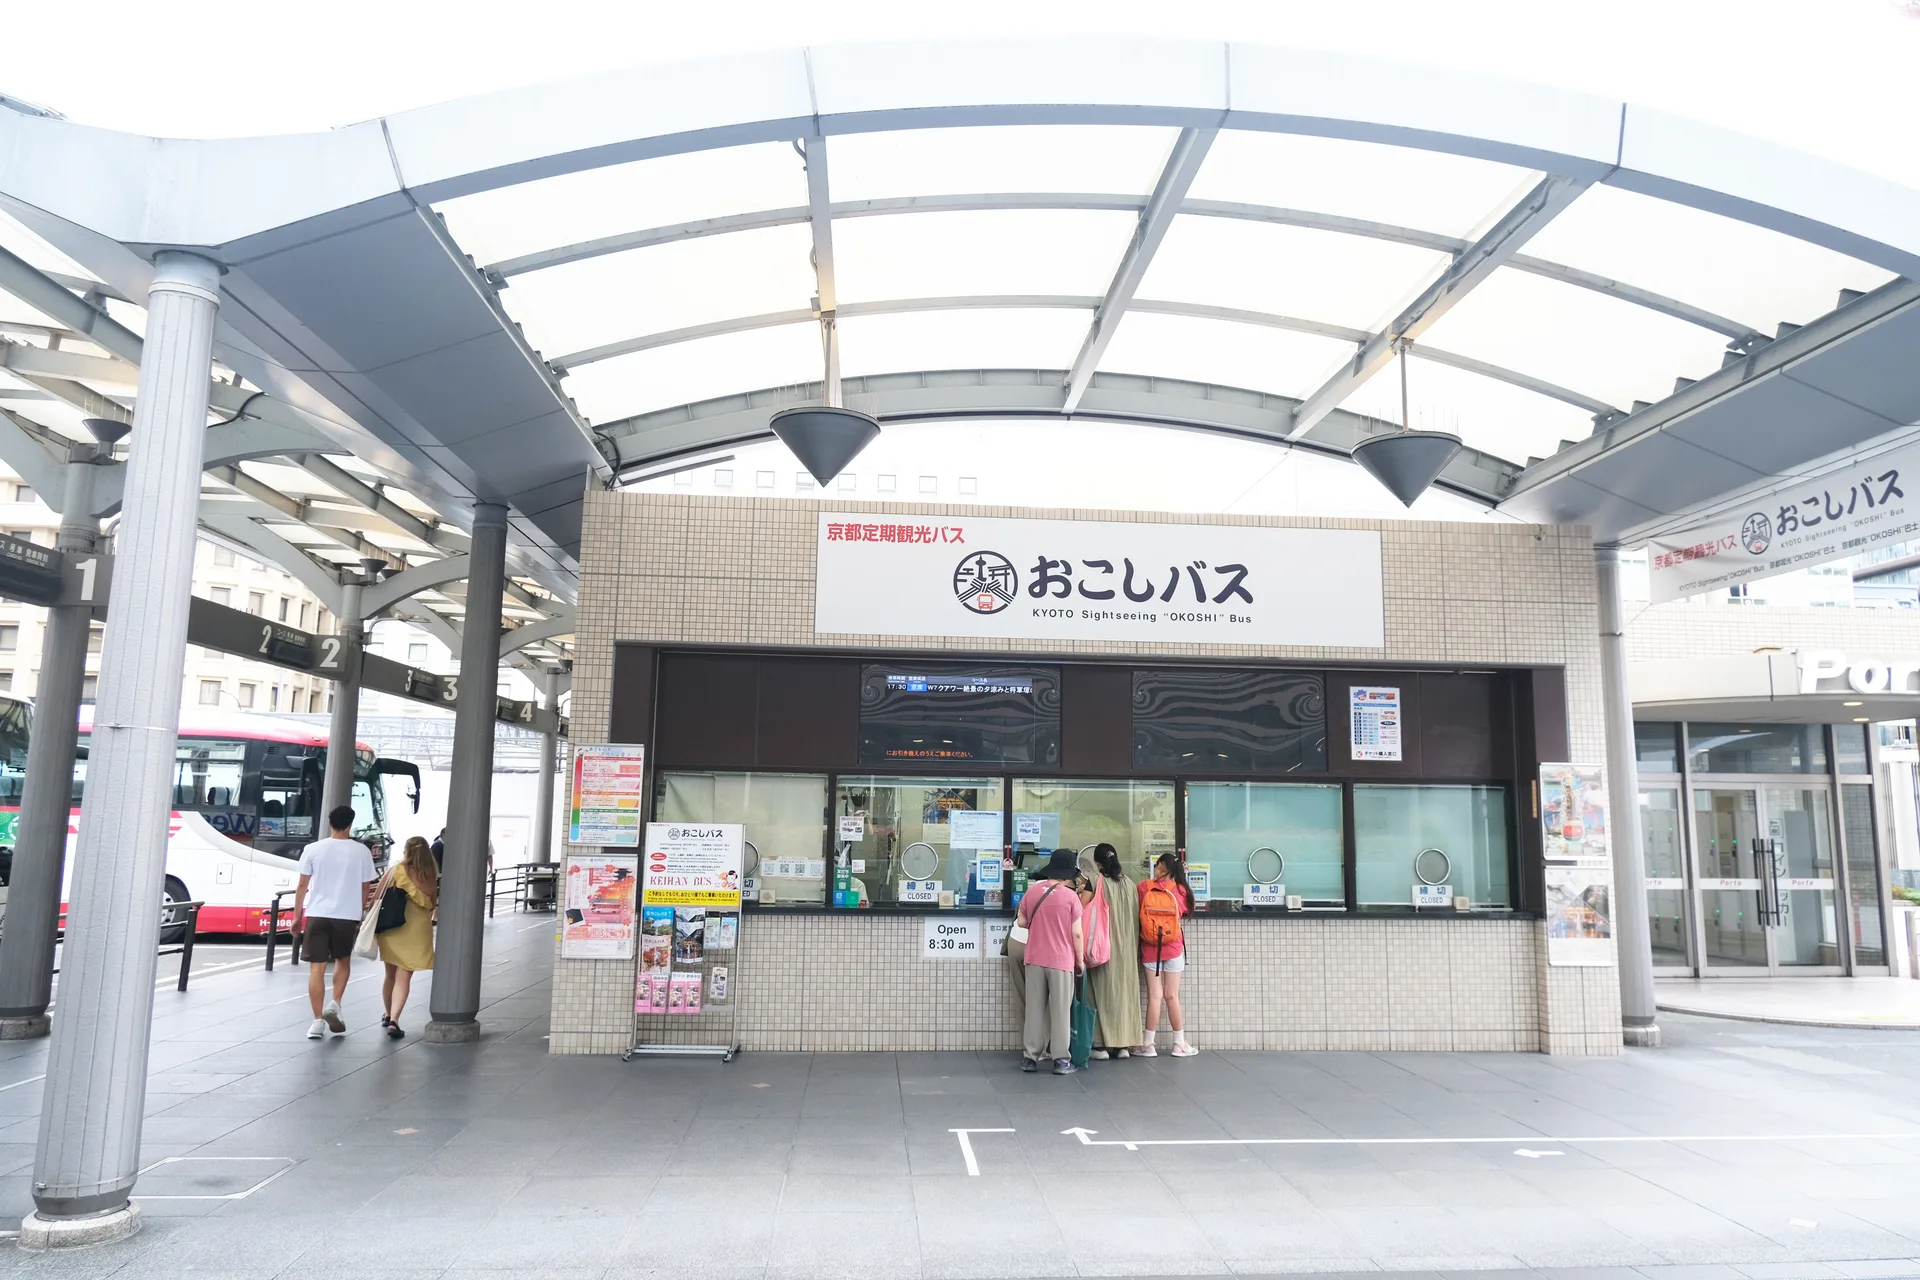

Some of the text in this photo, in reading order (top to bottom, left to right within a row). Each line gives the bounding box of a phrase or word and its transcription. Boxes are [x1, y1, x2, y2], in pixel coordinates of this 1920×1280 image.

[1776, 469, 1904, 536] おこしバス
[827, 522, 966, 545] 京都定期観光バス
[1780, 537, 1802, 548] KYOTO
[1805, 526, 1847, 542] Sightseeing
[1890, 508, 1905, 517] Bus
[1654, 535, 1738, 570] 京都定期観光バス
[76, 558, 97, 600] 1
[1027, 555, 1253, 604] おこしバス
[1679, 581, 1697, 591] KYOTO
[1032, 608, 1252, 623] KYOTO Sightseeing "OKOSHI" Bus
[259, 624, 272, 654] 2
[319, 638, 341, 668] 2
[405, 670, 458, 700] 3 3
[520, 703, 532, 722] 4
[681, 828, 723, 838] おこしバス
[650, 876, 712, 886] KEIHAN BUS
[1252, 895, 1277, 903] CLOSED
[937, 924, 966, 935] Open
[928, 939, 975, 950] 8:30 am
